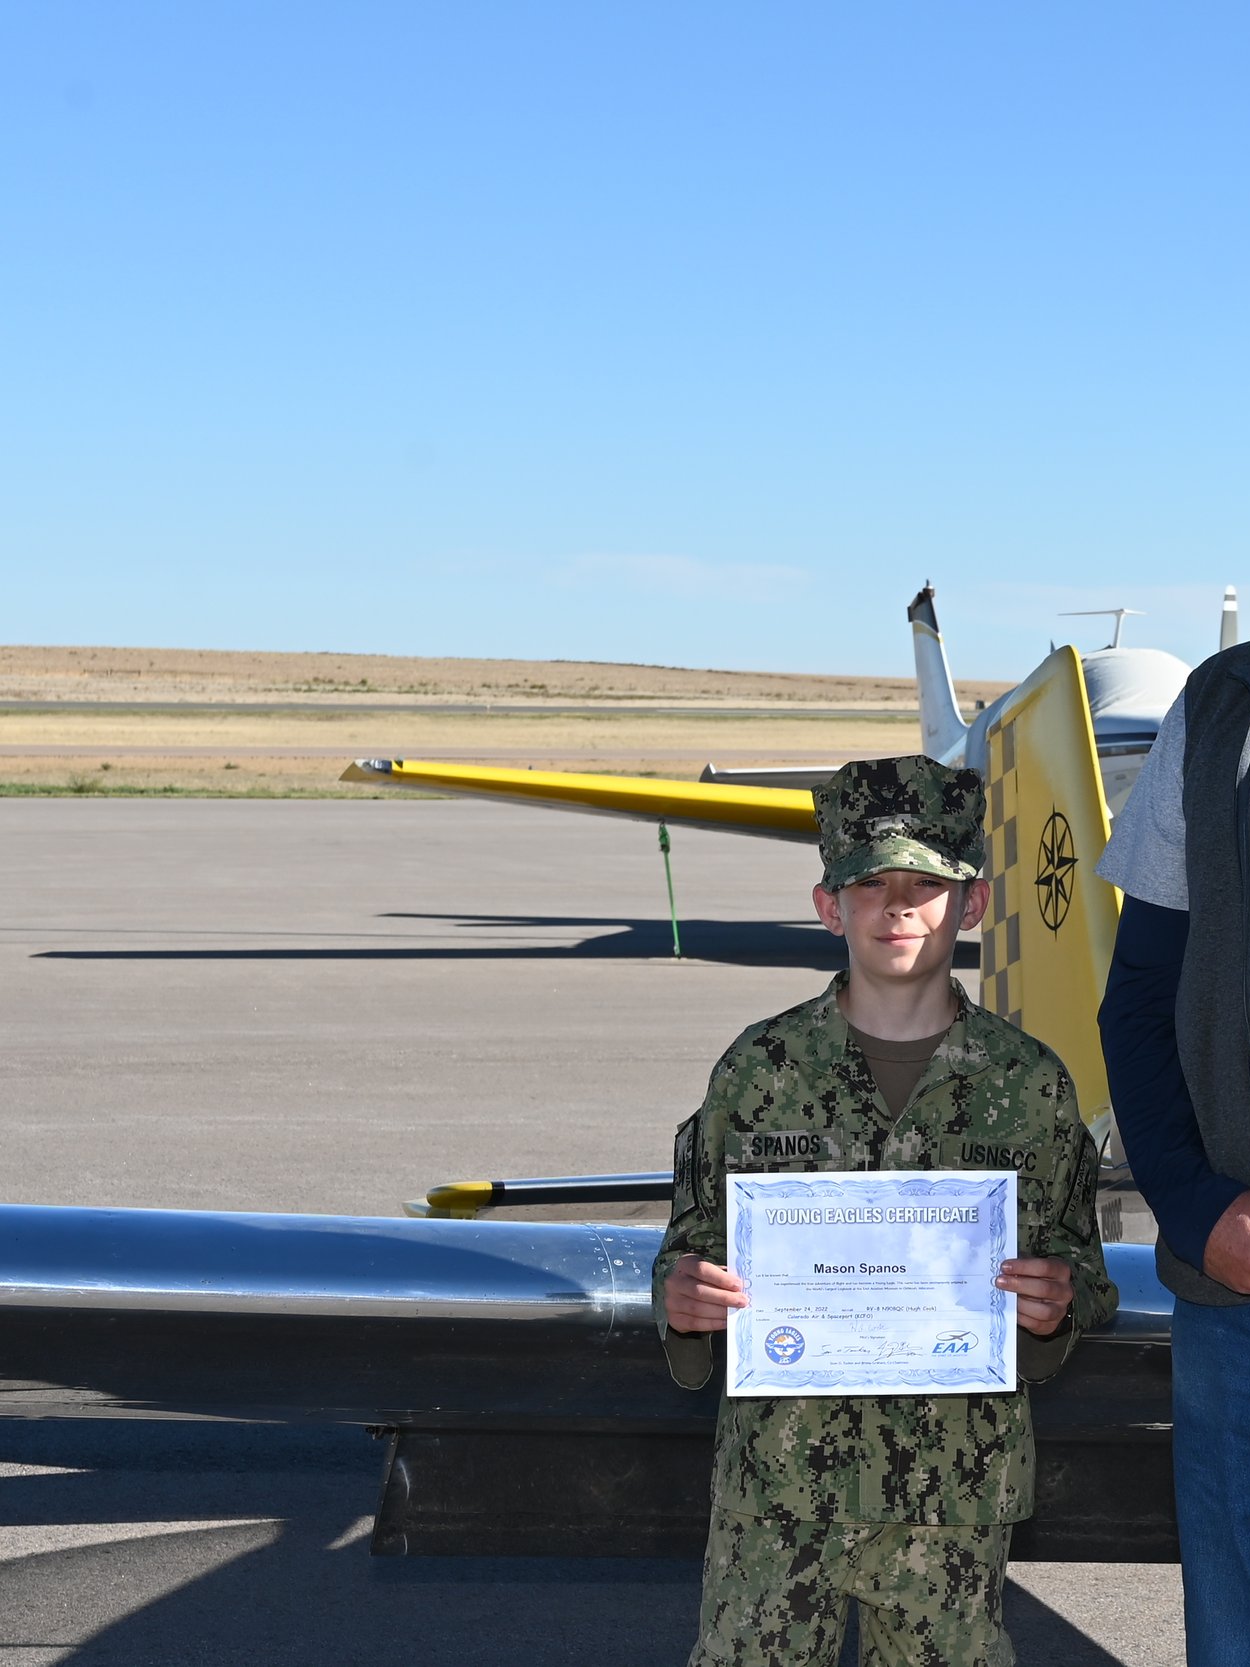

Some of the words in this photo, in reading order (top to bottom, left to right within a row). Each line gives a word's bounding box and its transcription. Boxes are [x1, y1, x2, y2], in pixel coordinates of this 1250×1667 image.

[751, 1134, 821, 1157] SPANOS
[961, 1142, 1037, 1172] USNSCC
[1068, 1193, 1081, 1213] U.S.
[765, 1208, 821, 1225] YOUNG
[824, 1207, 883, 1224] EAGLES
[885, 1206, 979, 1223] CERTIFICATE
[813, 1263, 855, 1274] Mason
[859, 1263, 907, 1276] Spanos
[768, 1327, 785, 1342] YOUNG
[785, 1327, 802, 1342] EAGLES
[932, 1342, 969, 1354] EAA
